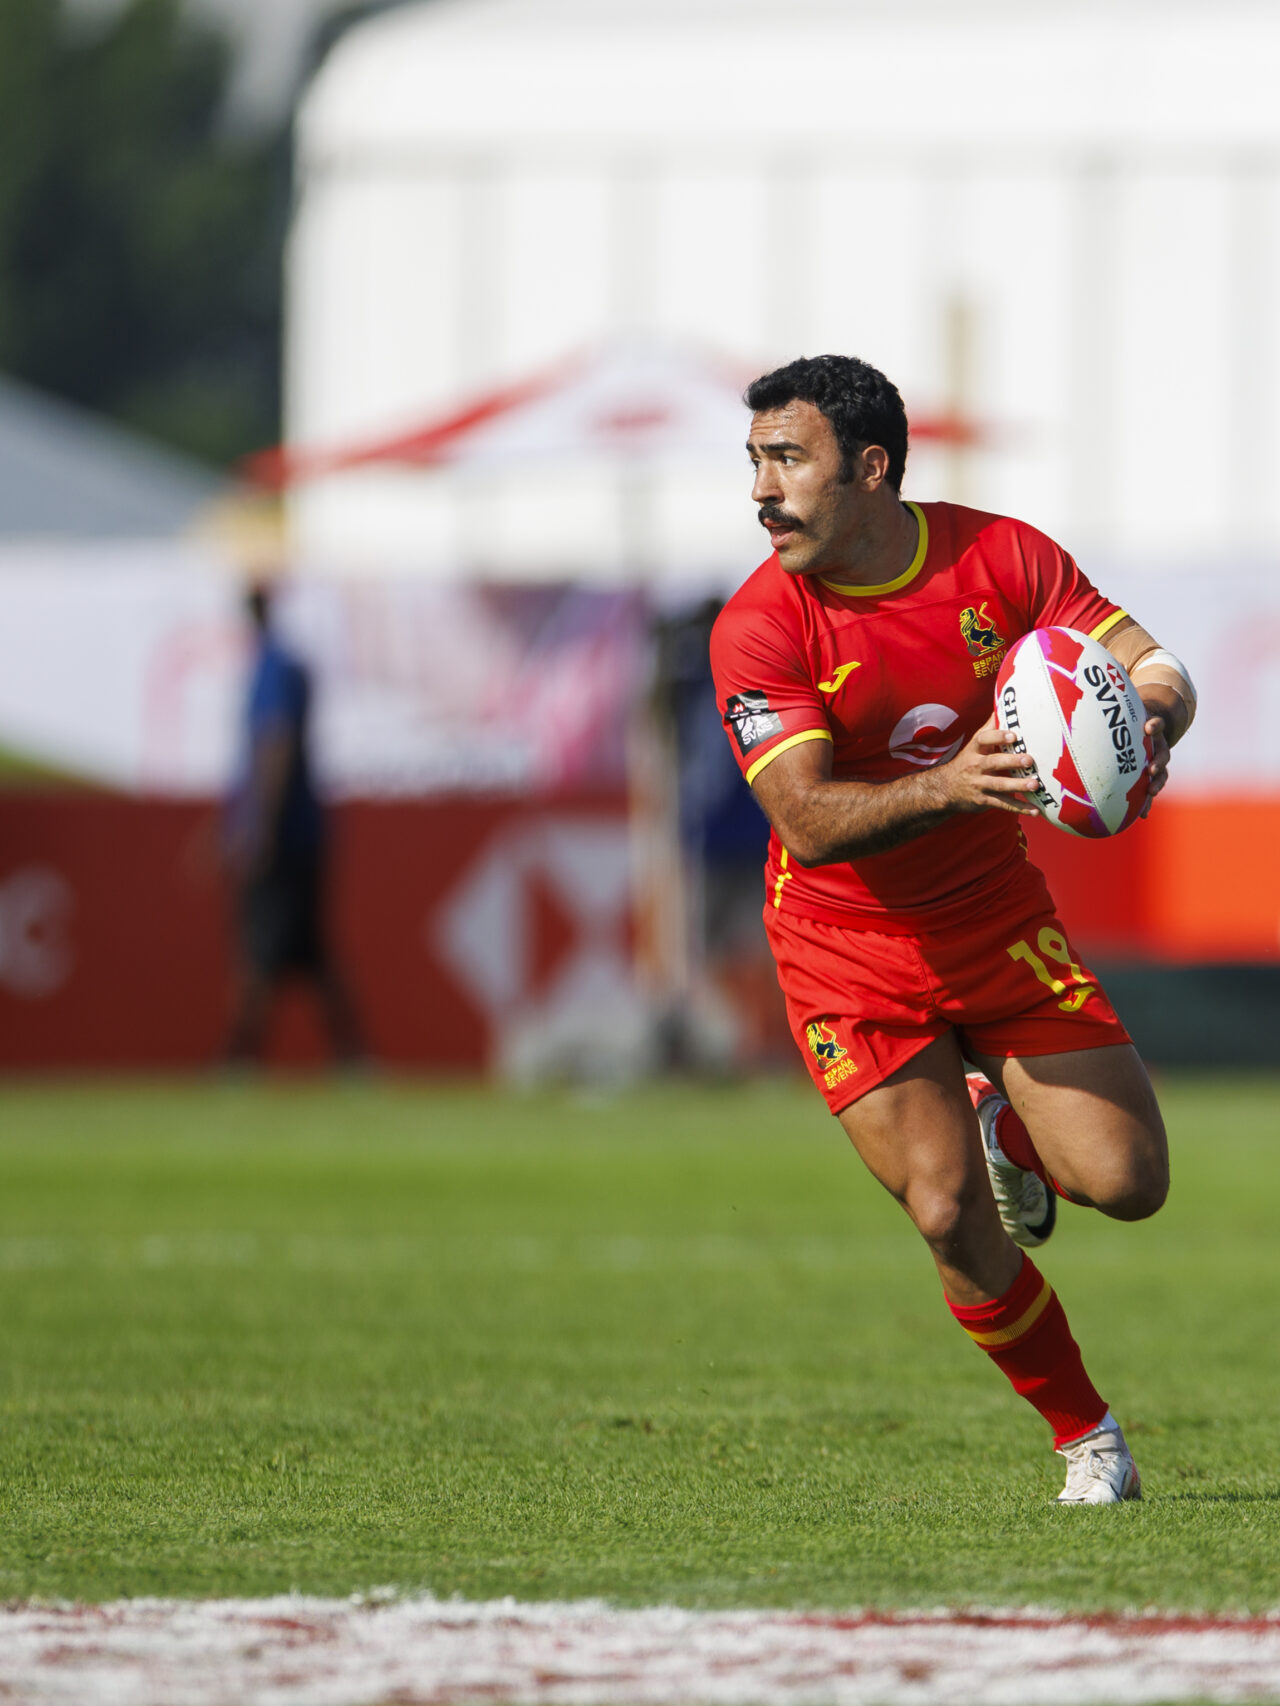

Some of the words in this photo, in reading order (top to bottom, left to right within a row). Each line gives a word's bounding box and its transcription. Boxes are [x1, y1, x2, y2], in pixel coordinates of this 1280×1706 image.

[975, 662, 1001, 678] SEVE
[1084, 665, 1131, 751] SVNS
[1006, 926, 1089, 995] 19
